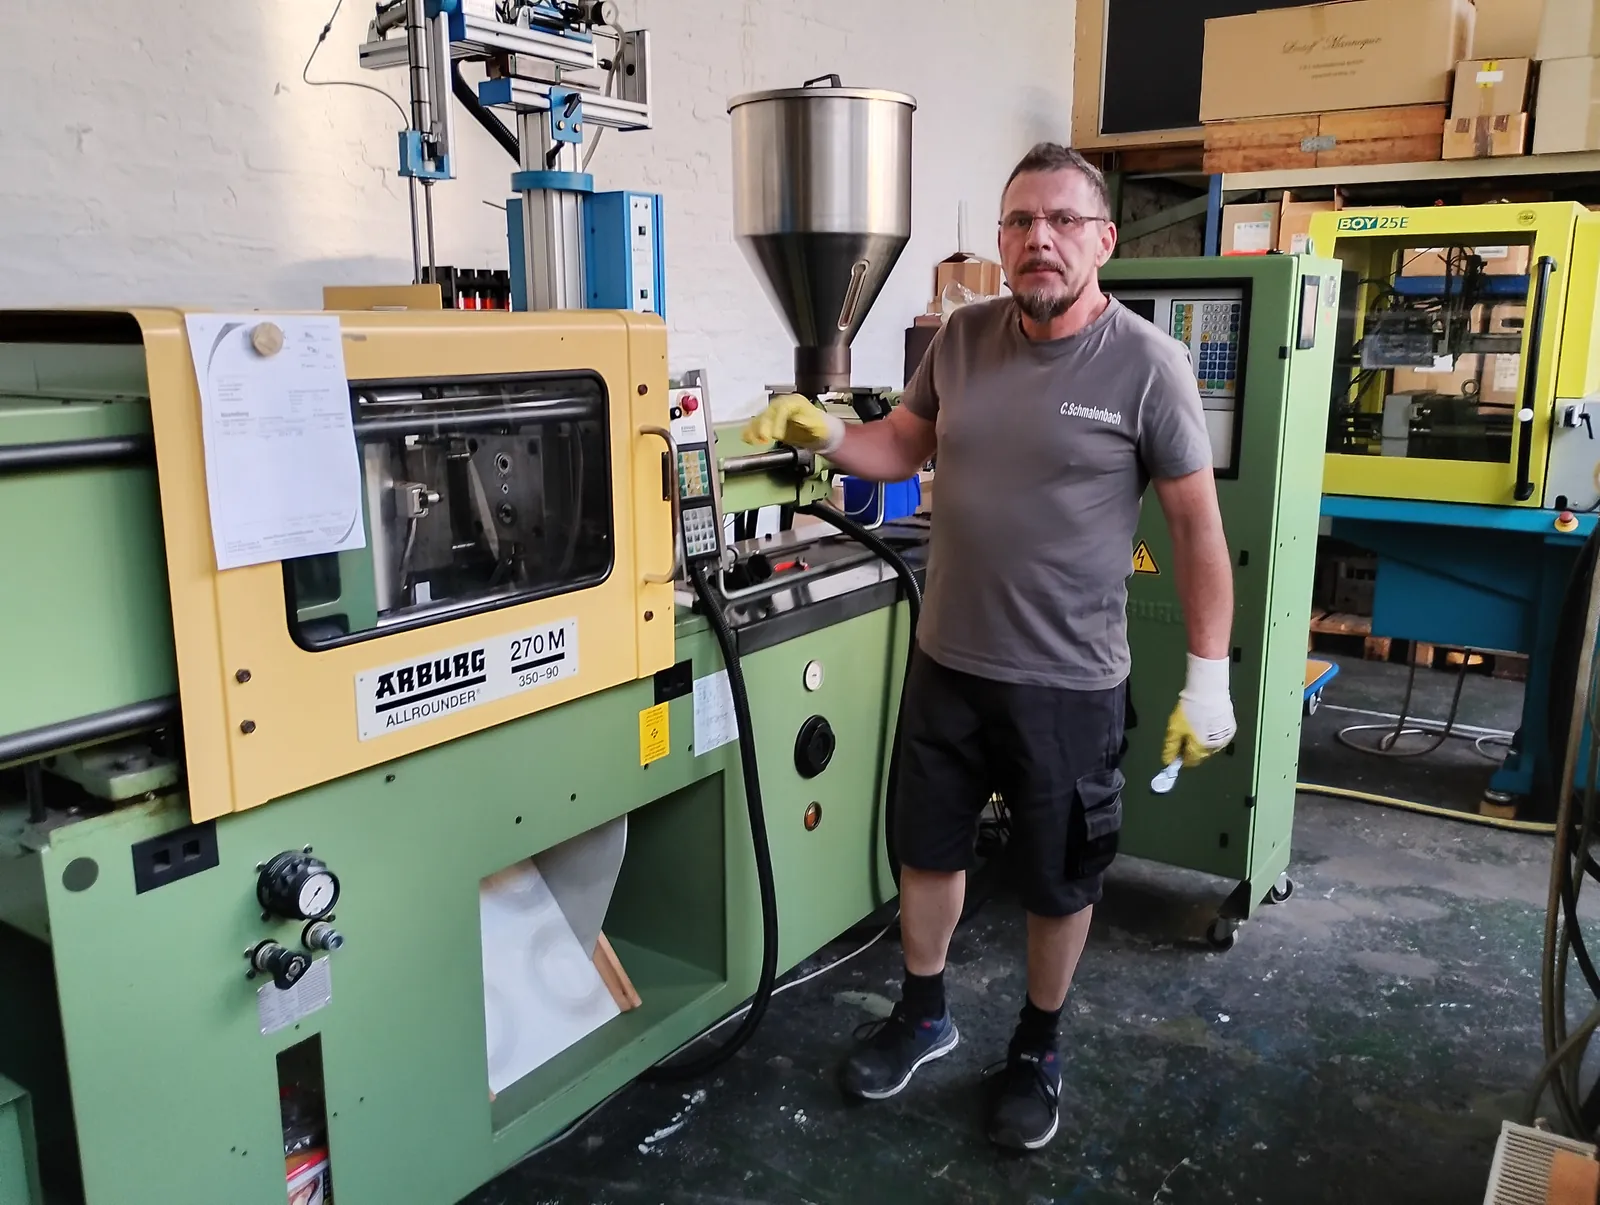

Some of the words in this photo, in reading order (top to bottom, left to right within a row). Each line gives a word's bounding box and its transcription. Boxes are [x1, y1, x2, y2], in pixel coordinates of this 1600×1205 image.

[1338, 217, 1377, 230] BOY
[1379, 217, 1409, 229] 25E
[1060, 402, 1122, 426] C.Schmalenbach
[510, 634, 544, 662] 270
[549, 628, 565, 651] M
[375, 648, 486, 699] ARBURG
[518, 665, 559, 687] 350-90
